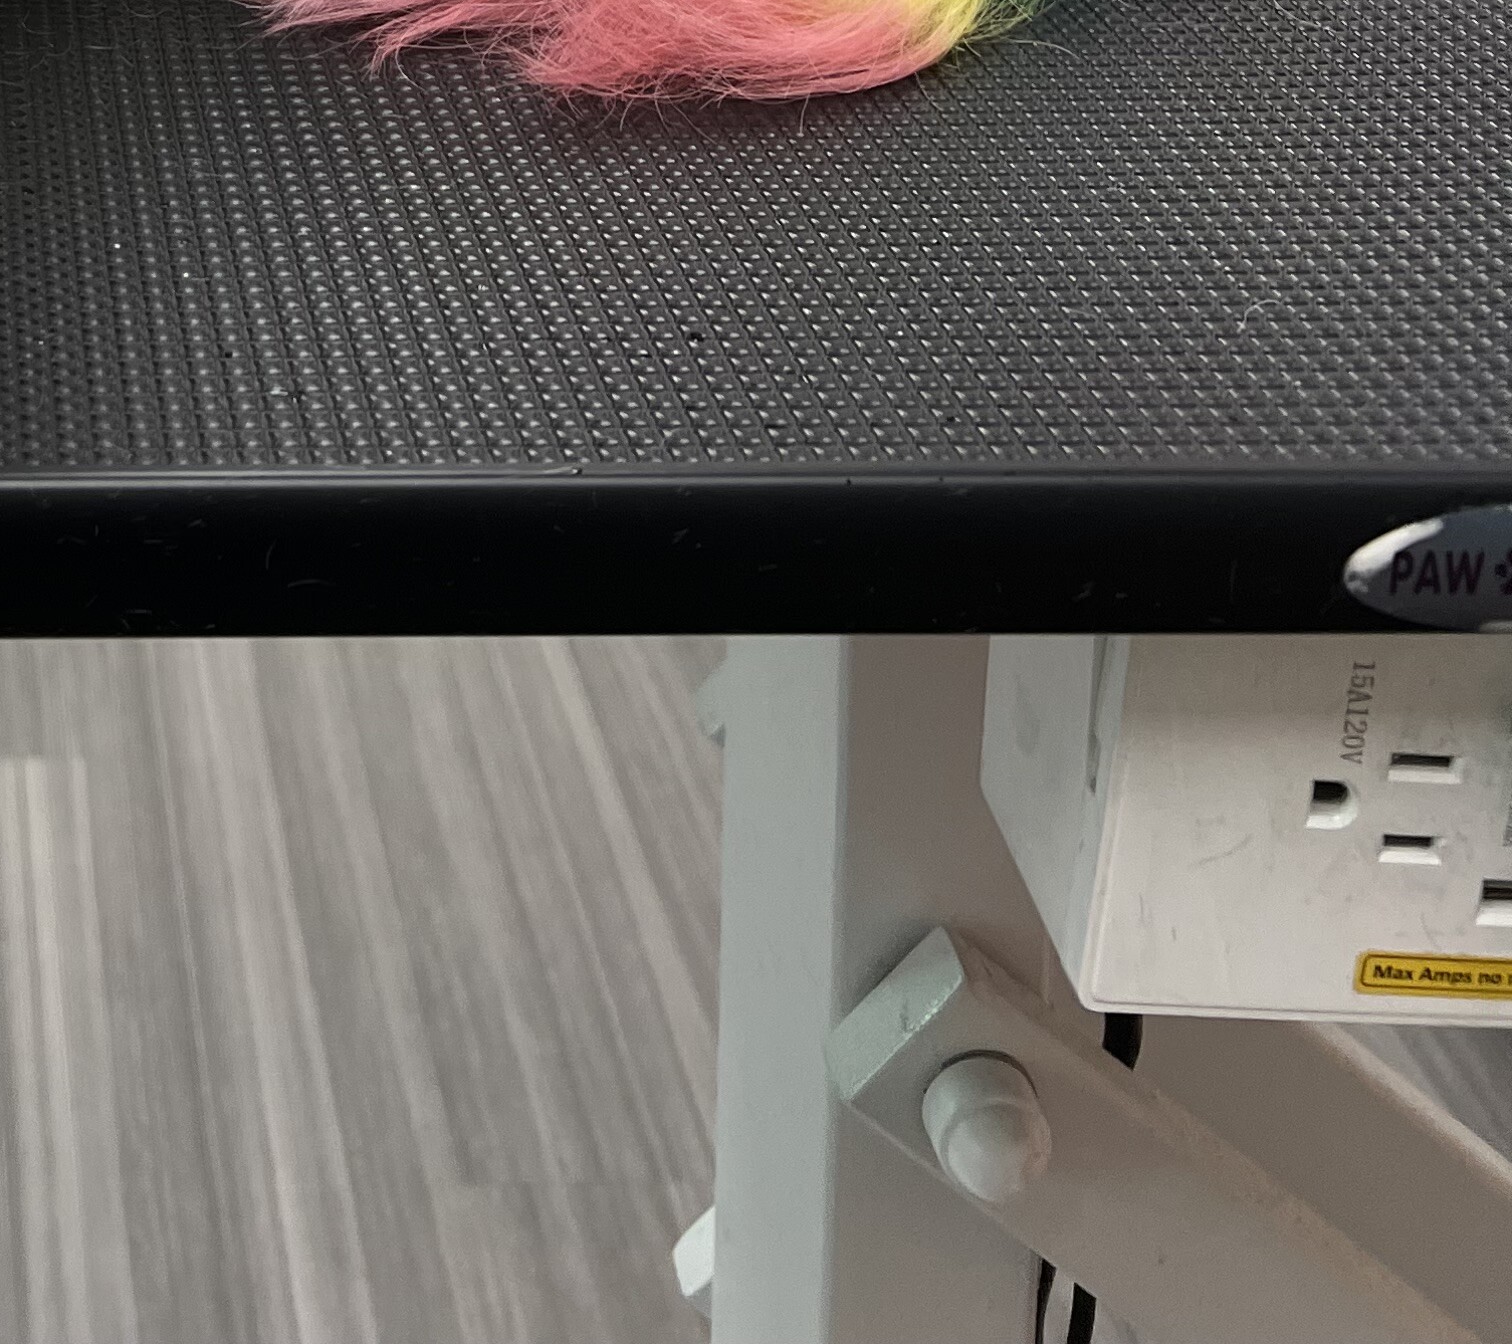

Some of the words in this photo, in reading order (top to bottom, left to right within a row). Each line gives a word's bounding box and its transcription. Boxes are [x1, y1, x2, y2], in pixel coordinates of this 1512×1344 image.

[1390, 550, 1485, 595] PAW
[1373, 964, 1413, 980] Max
[1418, 967, 1472, 984] Amps
